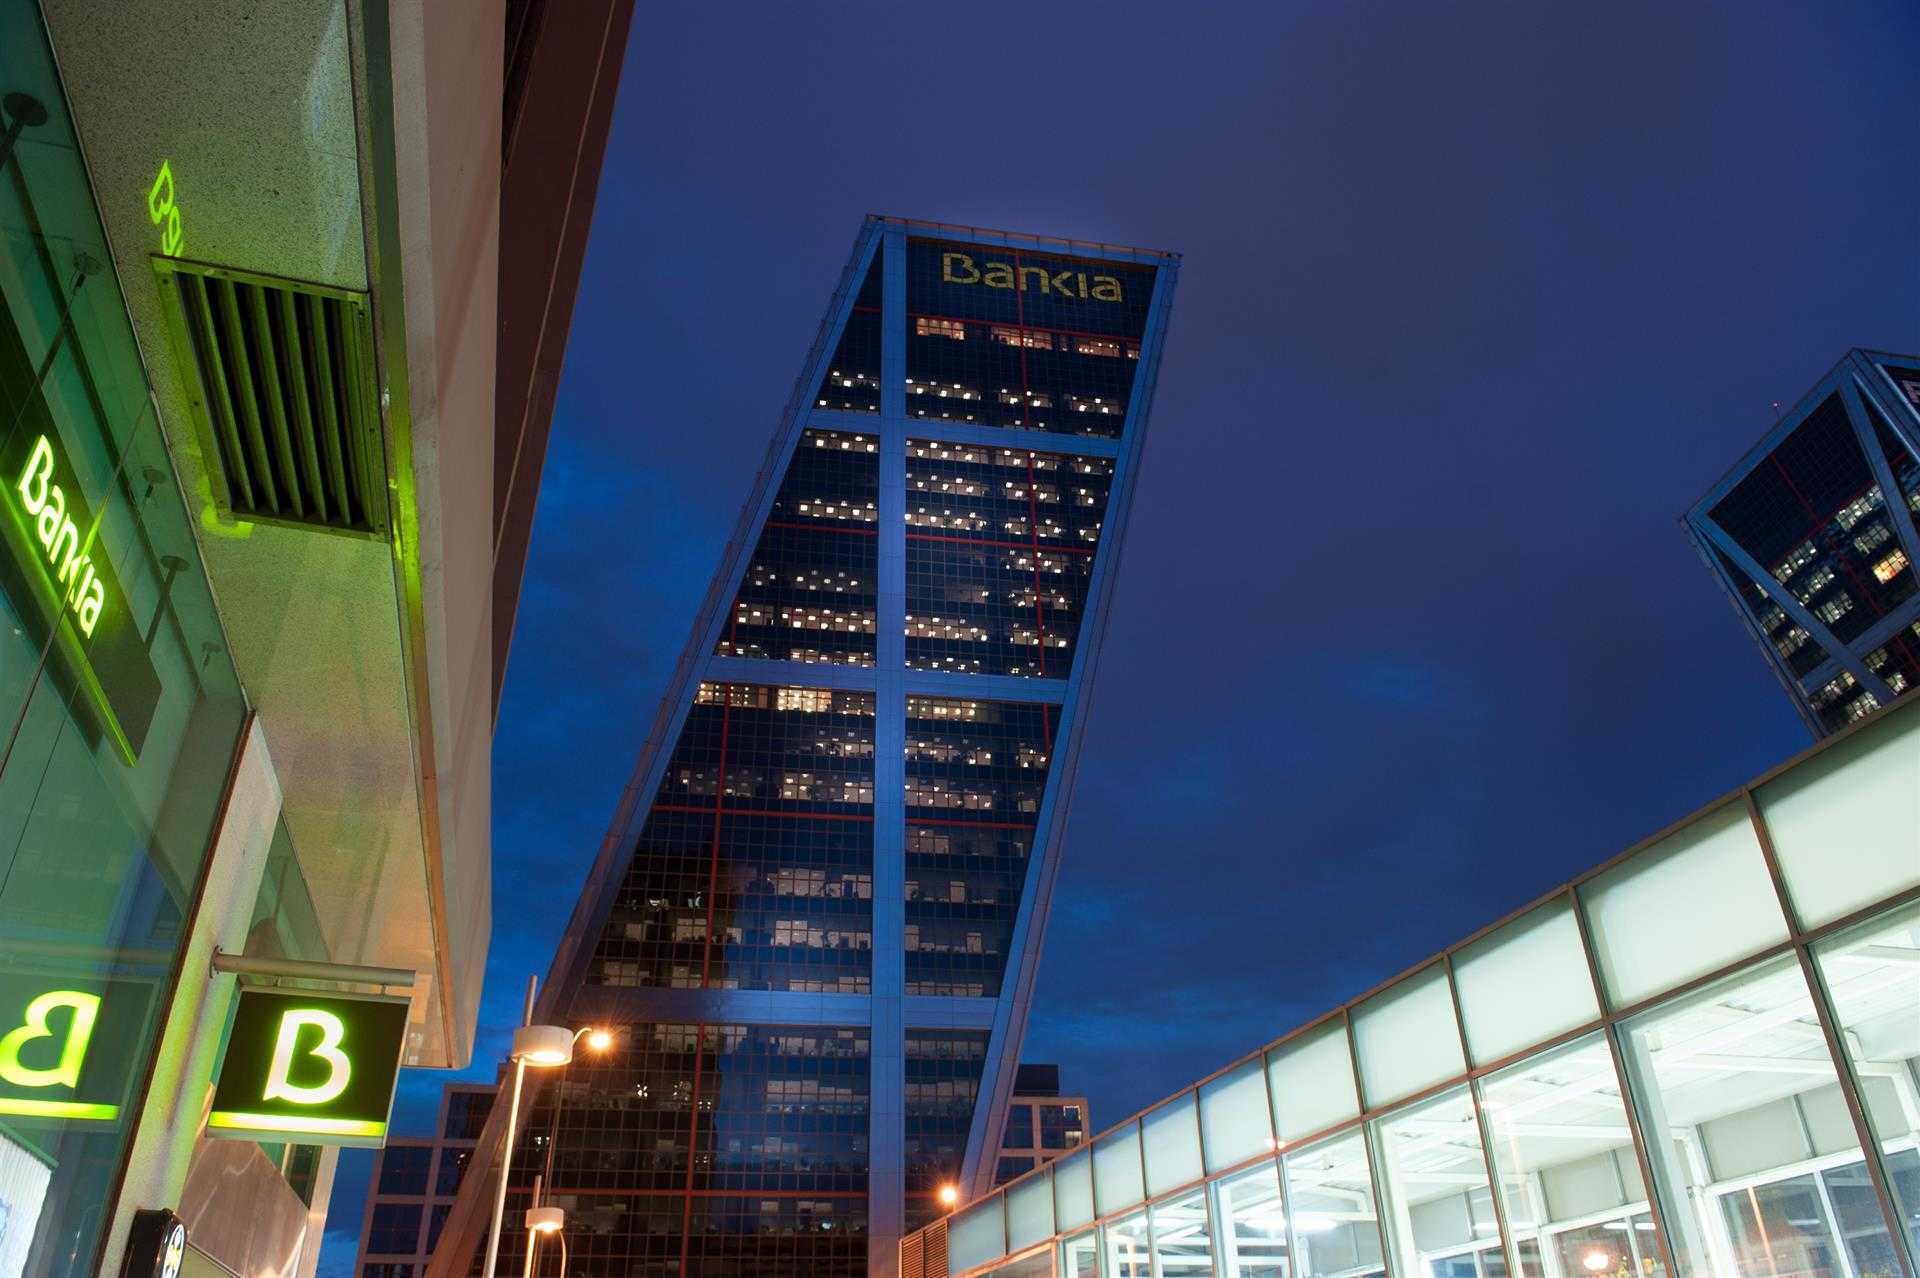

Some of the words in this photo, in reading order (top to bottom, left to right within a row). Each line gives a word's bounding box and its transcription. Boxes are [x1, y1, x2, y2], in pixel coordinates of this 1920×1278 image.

[943, 252, 1122, 302] Bankia
[18, 434, 105, 639] Bankia
[263, 1009, 351, 1104] B
